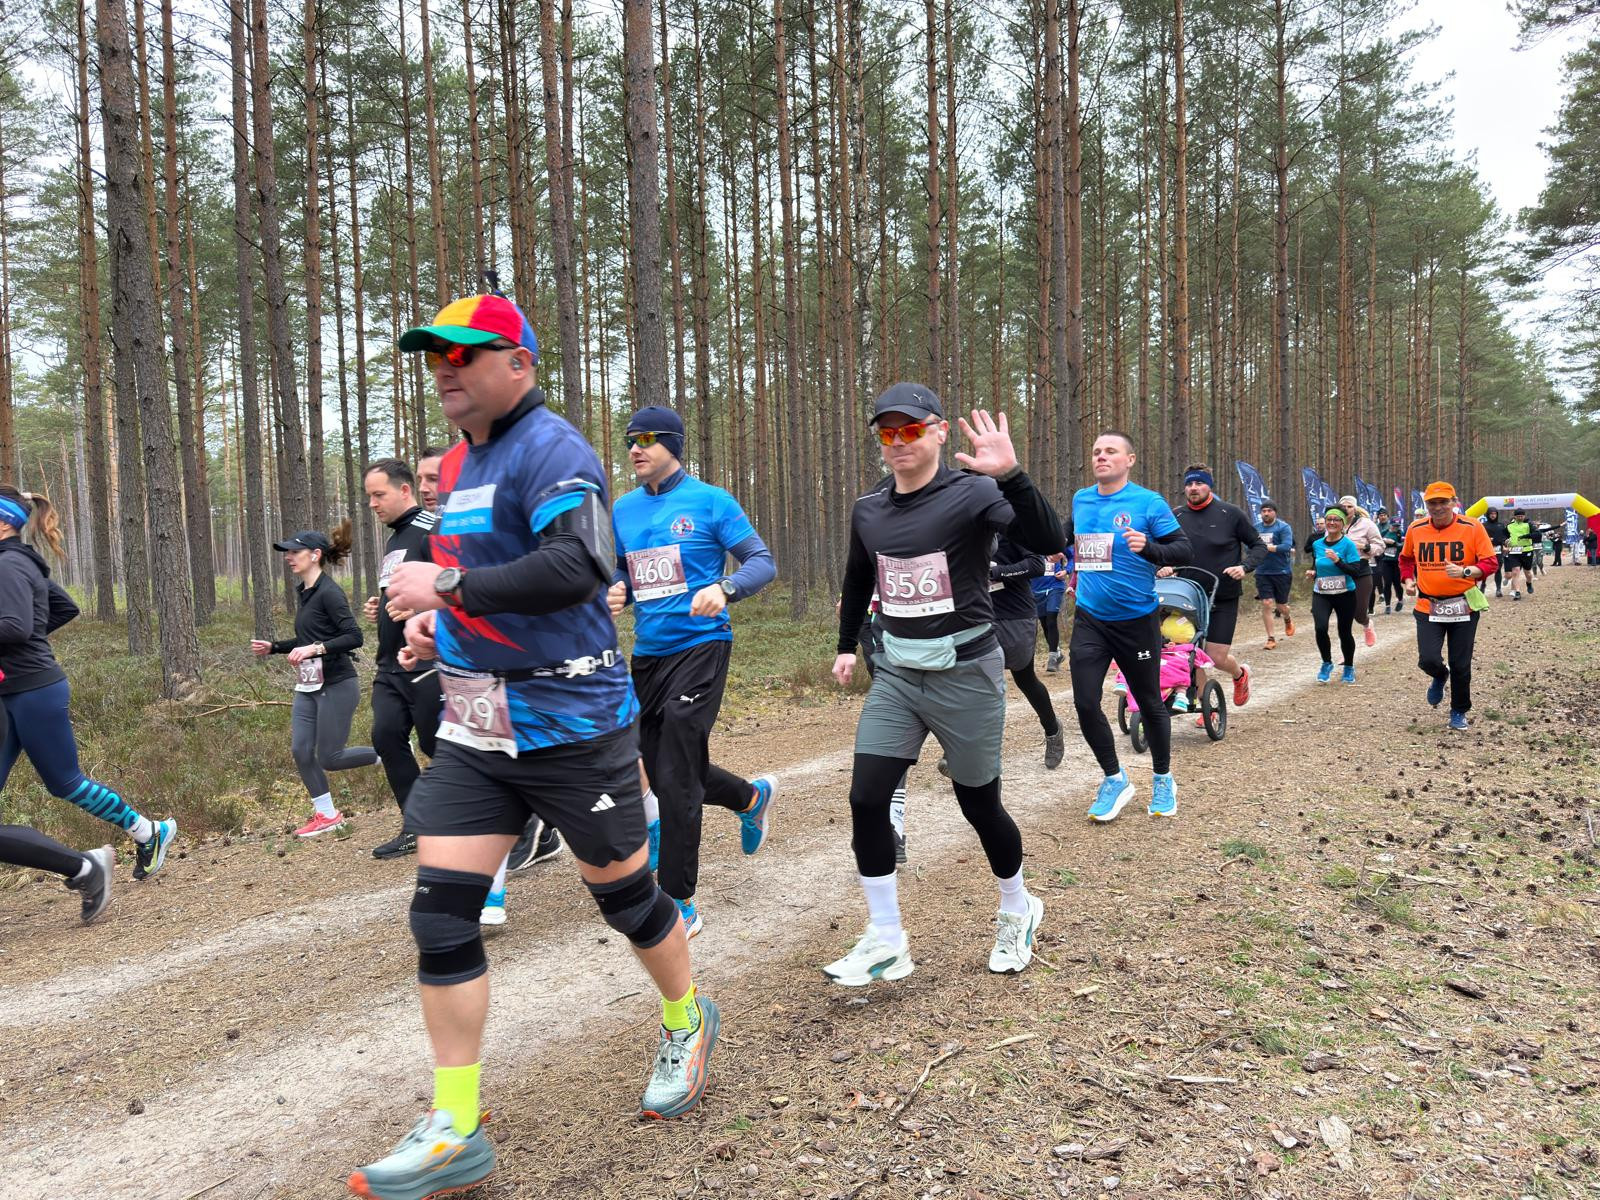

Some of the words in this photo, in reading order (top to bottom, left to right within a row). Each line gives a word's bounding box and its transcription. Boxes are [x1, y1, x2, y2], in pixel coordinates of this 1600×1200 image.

[1078, 542, 1105, 558] 445
[1418, 541, 1465, 562] MTB
[635, 557, 674, 584] 460
[885, 568, 938, 598] 556
[1321, 580, 1344, 590] 682
